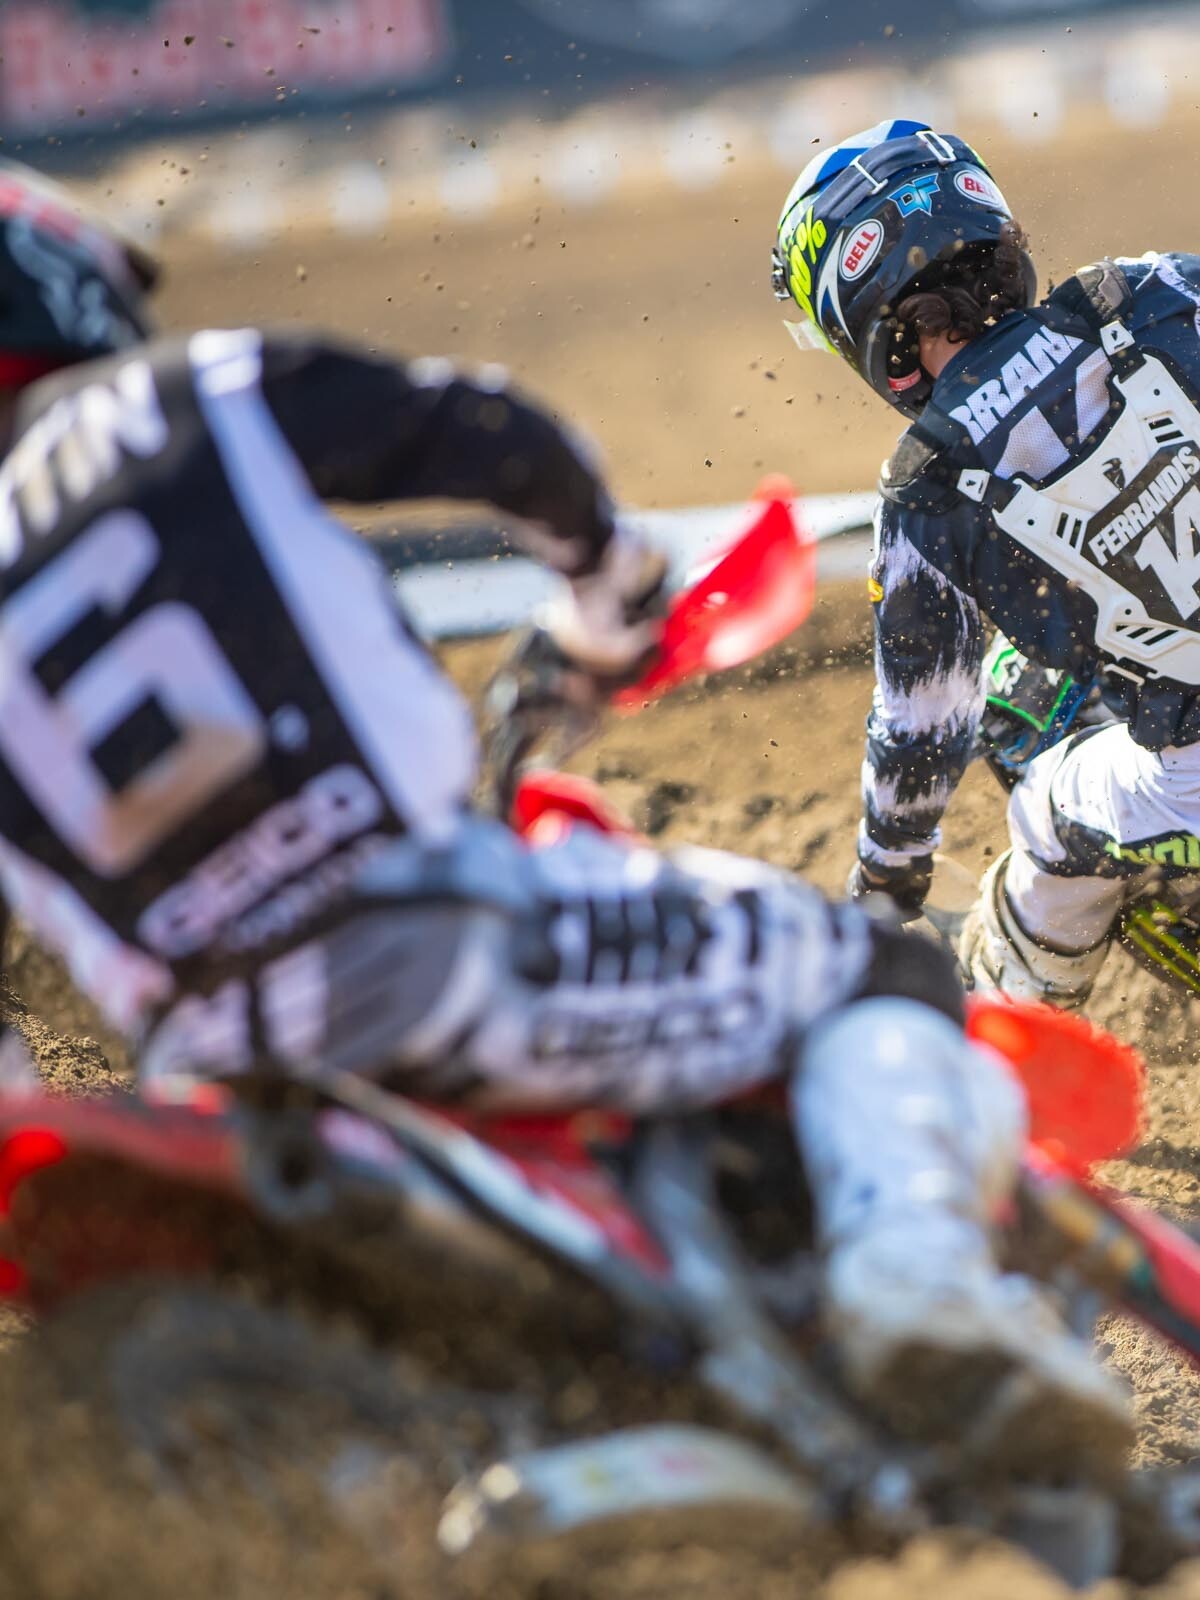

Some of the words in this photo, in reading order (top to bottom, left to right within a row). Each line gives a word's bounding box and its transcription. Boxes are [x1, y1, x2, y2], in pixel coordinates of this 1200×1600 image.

[844, 230, 877, 273] BELL
[1088, 446, 1200, 567] FERRANDIS
[0, 508, 264, 878] 6
